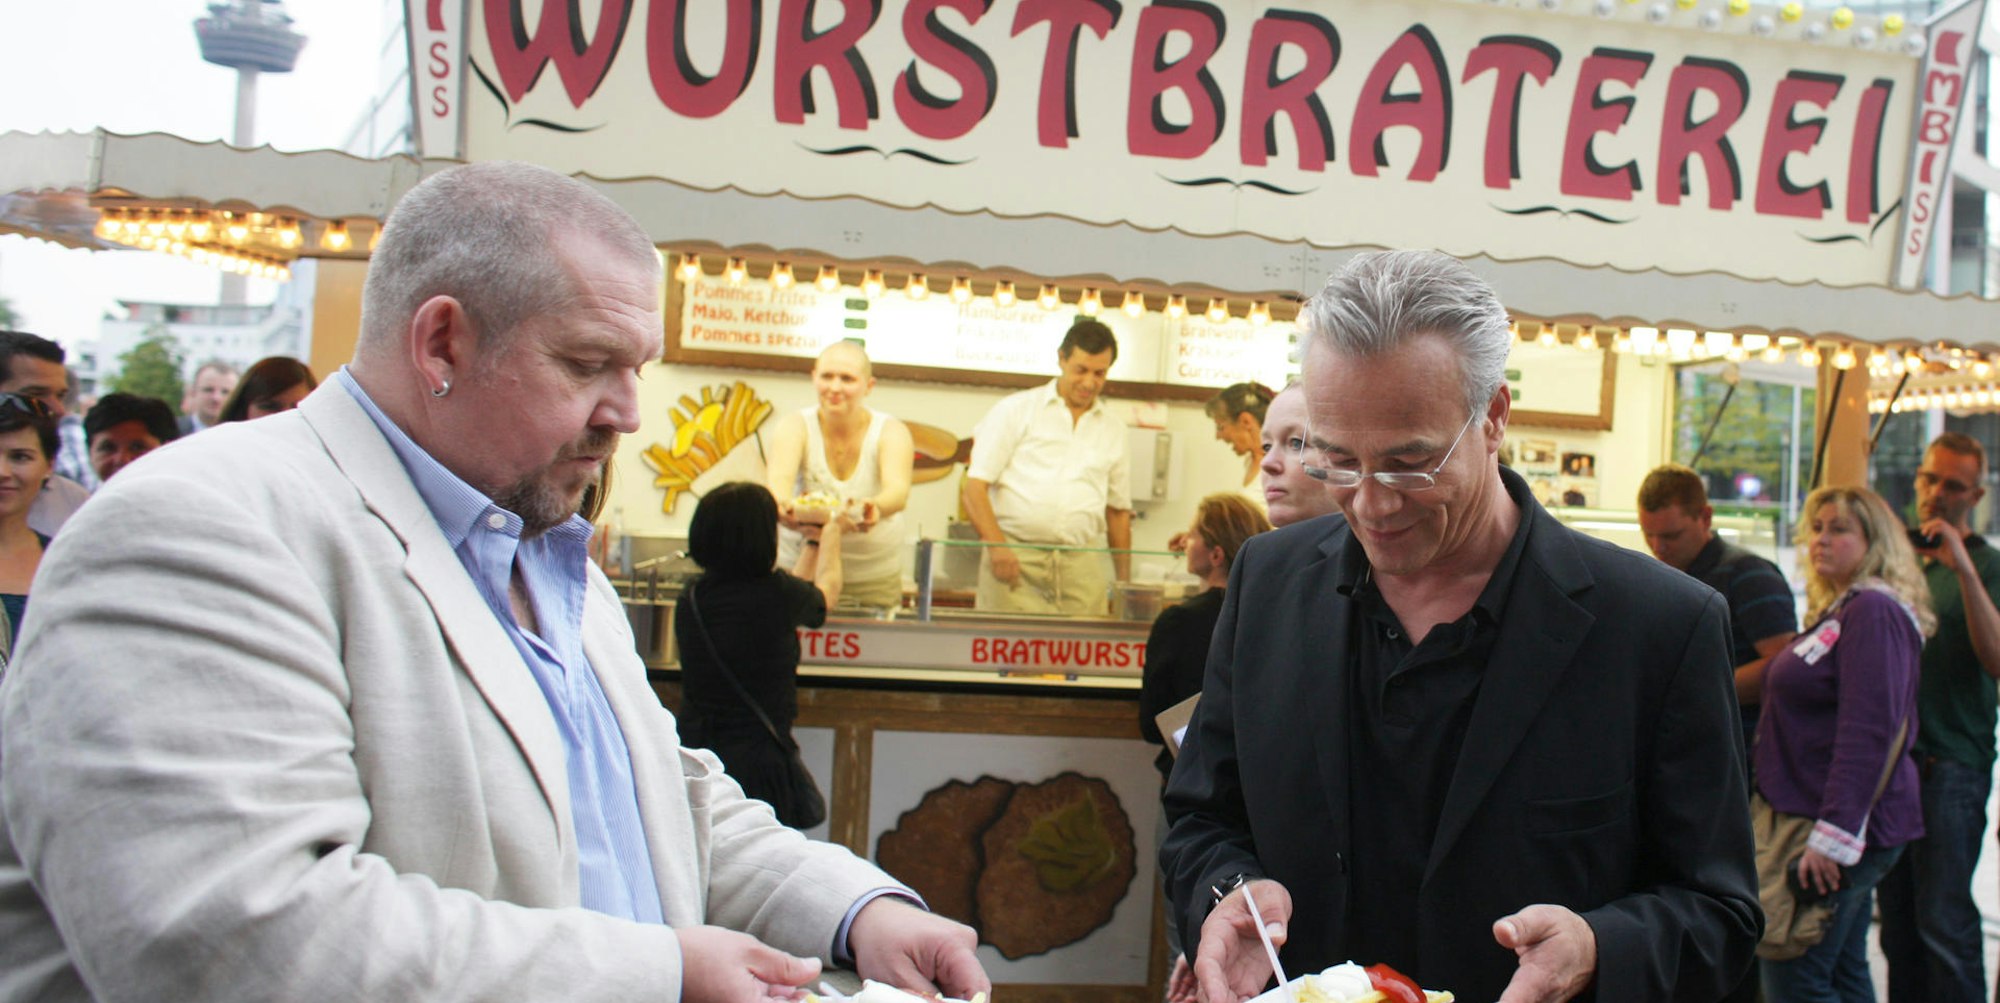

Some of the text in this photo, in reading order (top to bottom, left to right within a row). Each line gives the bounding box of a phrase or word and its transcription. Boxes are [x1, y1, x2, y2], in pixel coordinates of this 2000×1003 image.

[482, 0, 1893, 224] WURSTBRATEREI
[1908, 30, 1965, 256] IMBISS
[693, 280, 817, 306] Pommes Frites
[690, 324, 762, 345] Pommes
[971, 637, 1147, 668] BRATWURST
